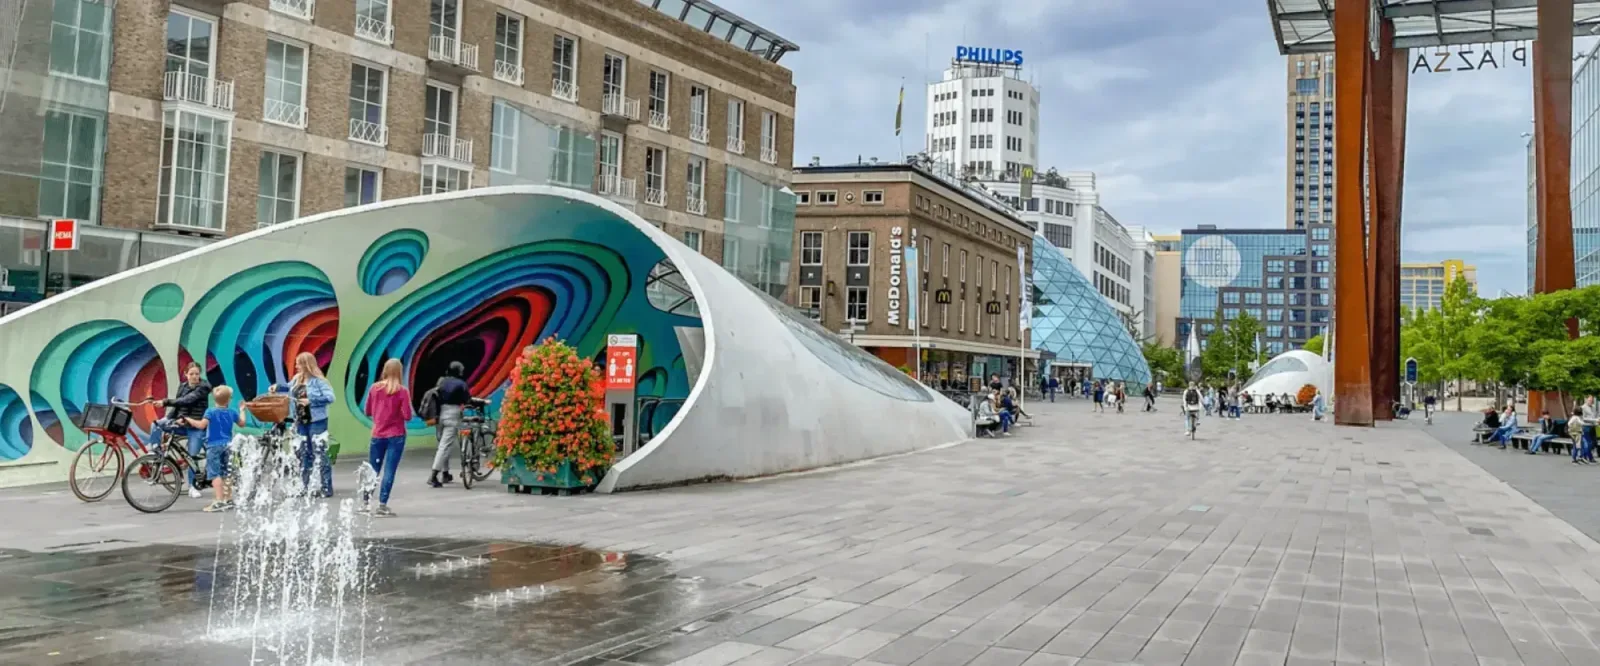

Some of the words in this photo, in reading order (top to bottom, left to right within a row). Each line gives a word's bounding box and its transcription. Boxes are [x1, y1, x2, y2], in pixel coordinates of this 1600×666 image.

[955, 46, 1024, 65] PHILIPS
[55, 230, 73, 240] HEMA
[888, 226, 902, 325] McDonald's
